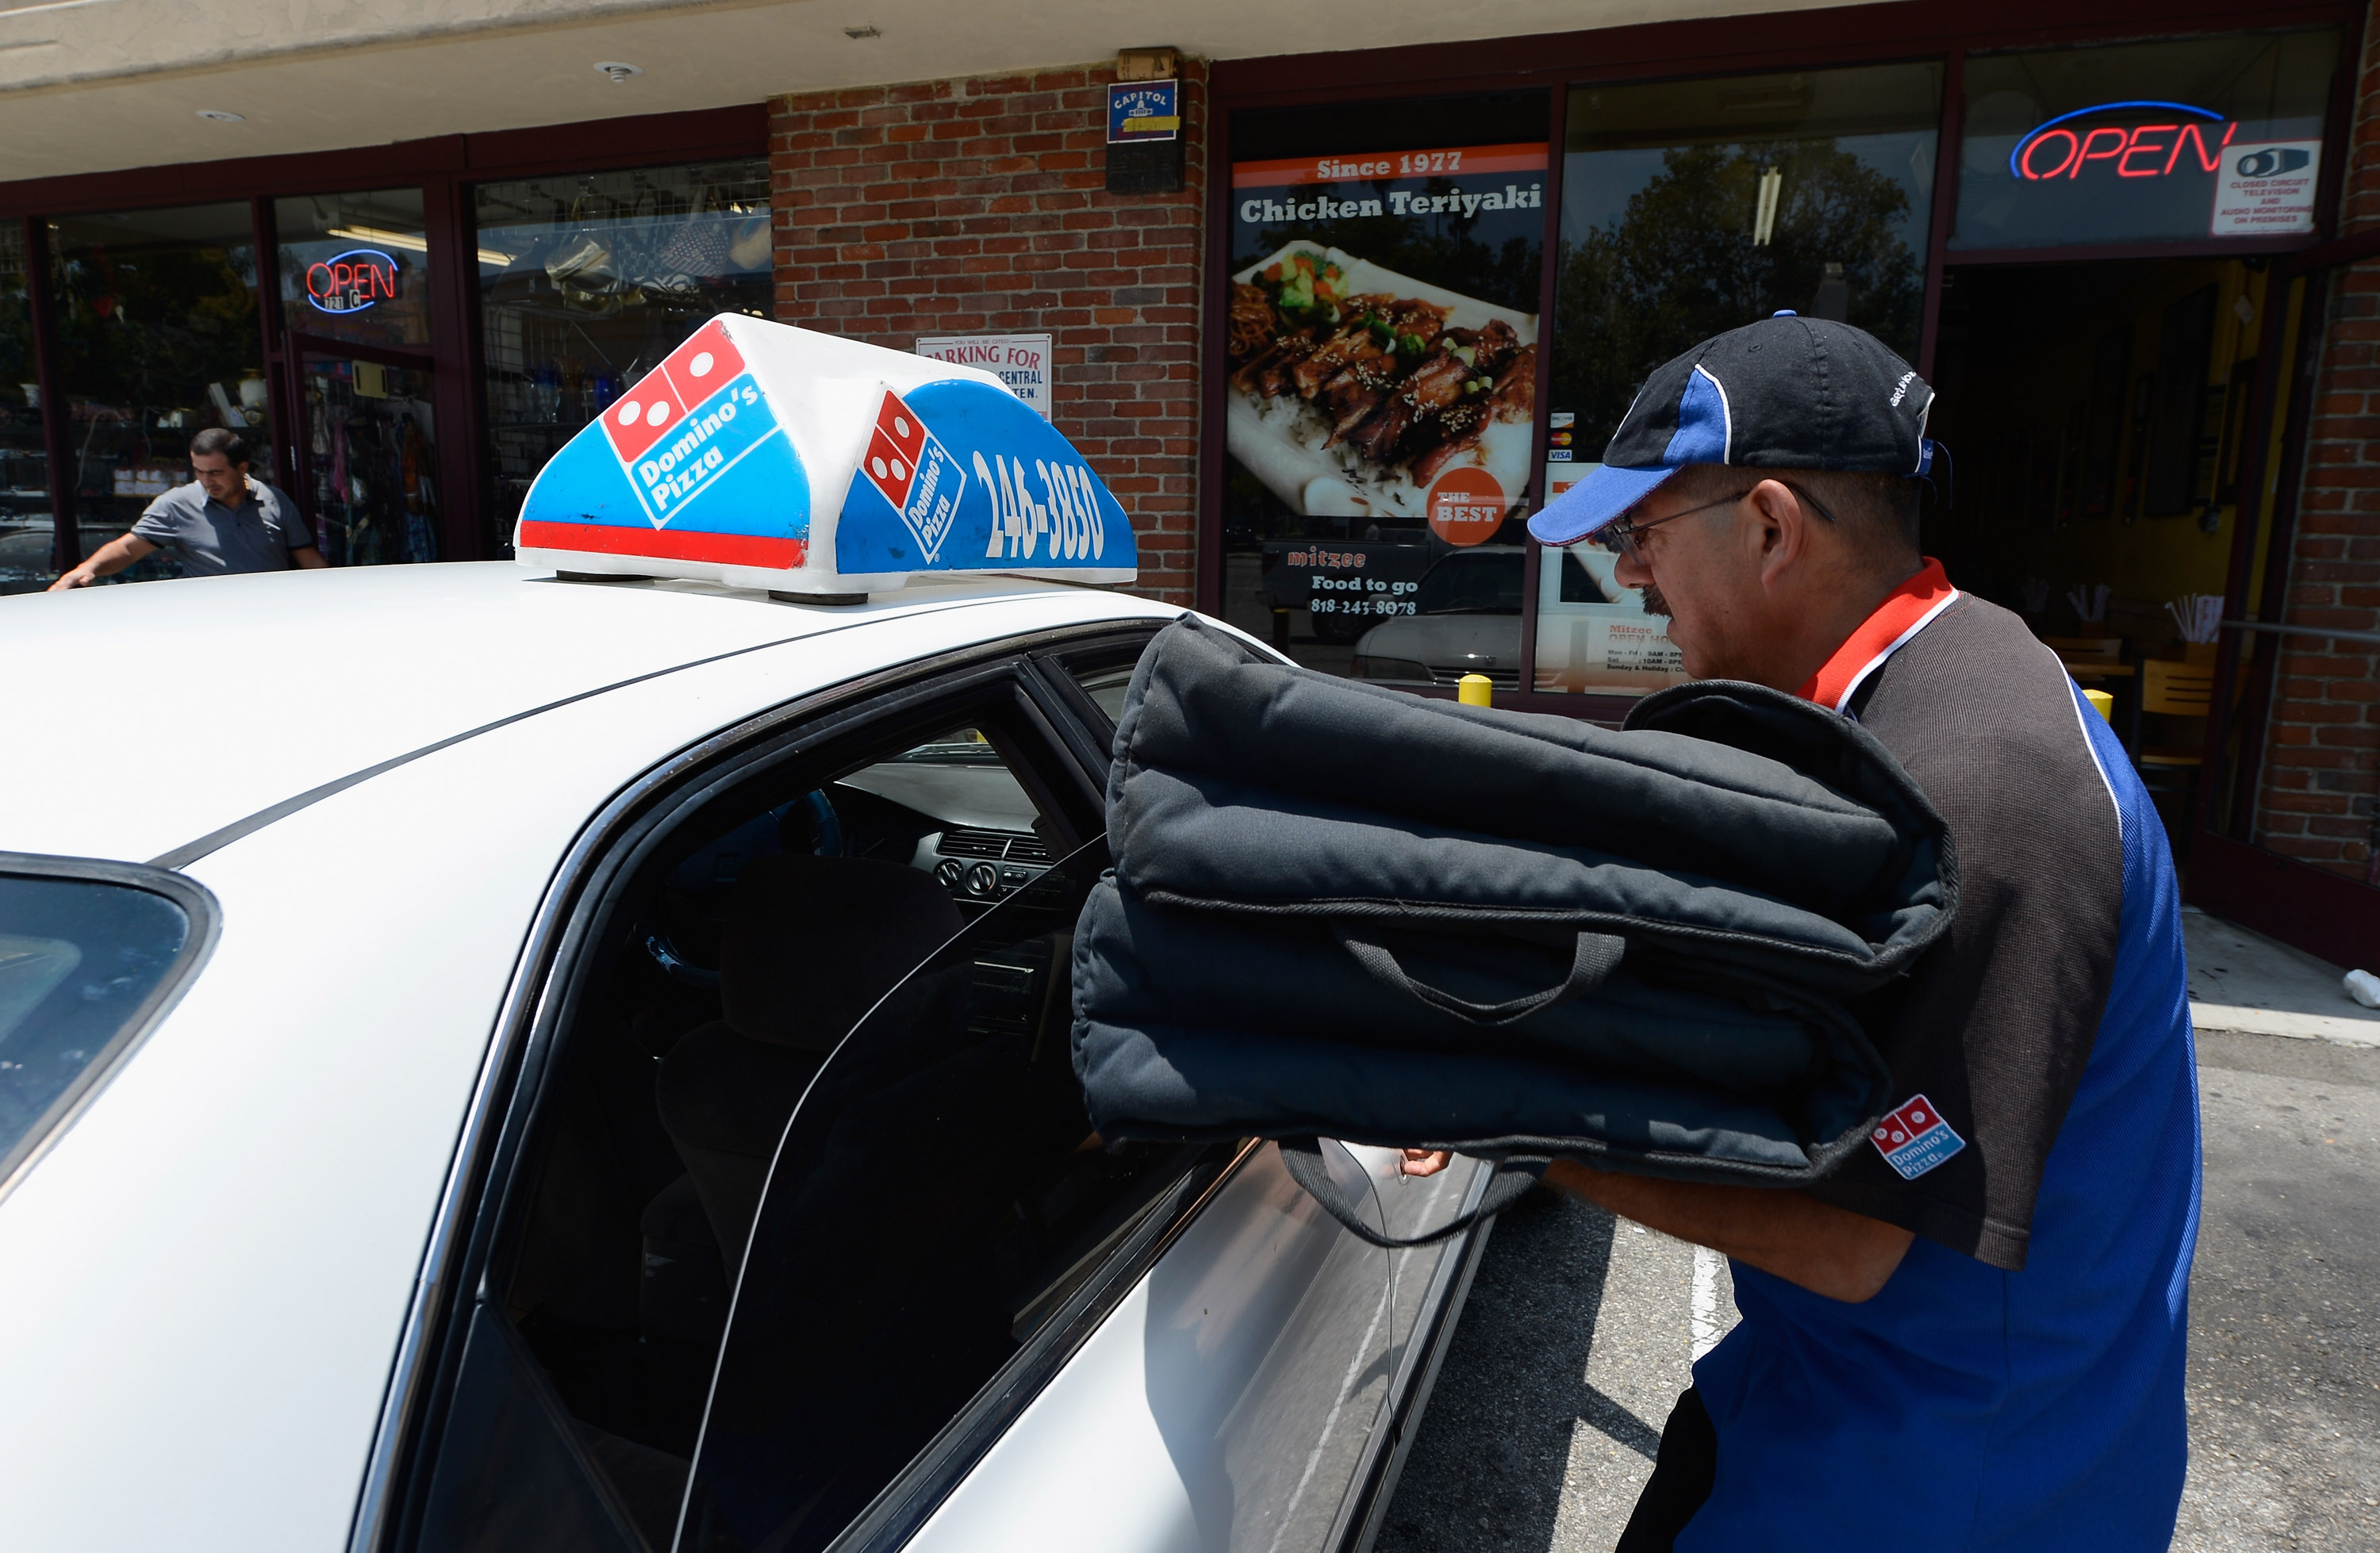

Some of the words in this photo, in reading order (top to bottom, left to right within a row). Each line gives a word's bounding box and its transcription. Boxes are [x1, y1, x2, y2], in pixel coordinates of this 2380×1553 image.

[1114, 91, 1166, 109] CAPITOL
[2021, 121, 2238, 181] OPEN
[1317, 159, 1391, 179] Since
[1400, 151, 1462, 174] 1977
[2230, 180, 2268, 190] CLOSED
[2271, 178, 2310, 187] CIRCUIT
[2244, 188, 2300, 197] TELEVISION
[1240, 196, 1383, 223] Chicken
[1389, 183, 1541, 219] Teriyaki
[2253, 205, 2313, 214] MONITORING
[306, 262, 393, 298] OPEN
[325, 297, 343, 309] 721
[351, 291, 359, 308] C
[926, 346, 1000, 364] ARKING
[1007, 347, 1041, 370] FOR
[999, 370, 1043, 385] CENTRAL
[638, 385, 758, 489] Domino's
[651, 446, 724, 512] Pizza
[908, 446, 945, 529] Domino's
[973, 451, 1104, 560] 246-3850
[1438, 492, 1470, 503] THE
[921, 493, 951, 548] Pizza
[1437, 506, 1497, 522] BEST
[1288, 546, 1366, 569] mitzee
[1311, 576, 1361, 591] Food
[1366, 578, 1388, 592] to
[1392, 581, 1418, 596] go
[1311, 598, 1417, 615] 818-243-8078
[1609, 634, 1645, 642] OPEN
[1891, 1129, 1949, 1167] Domino's
